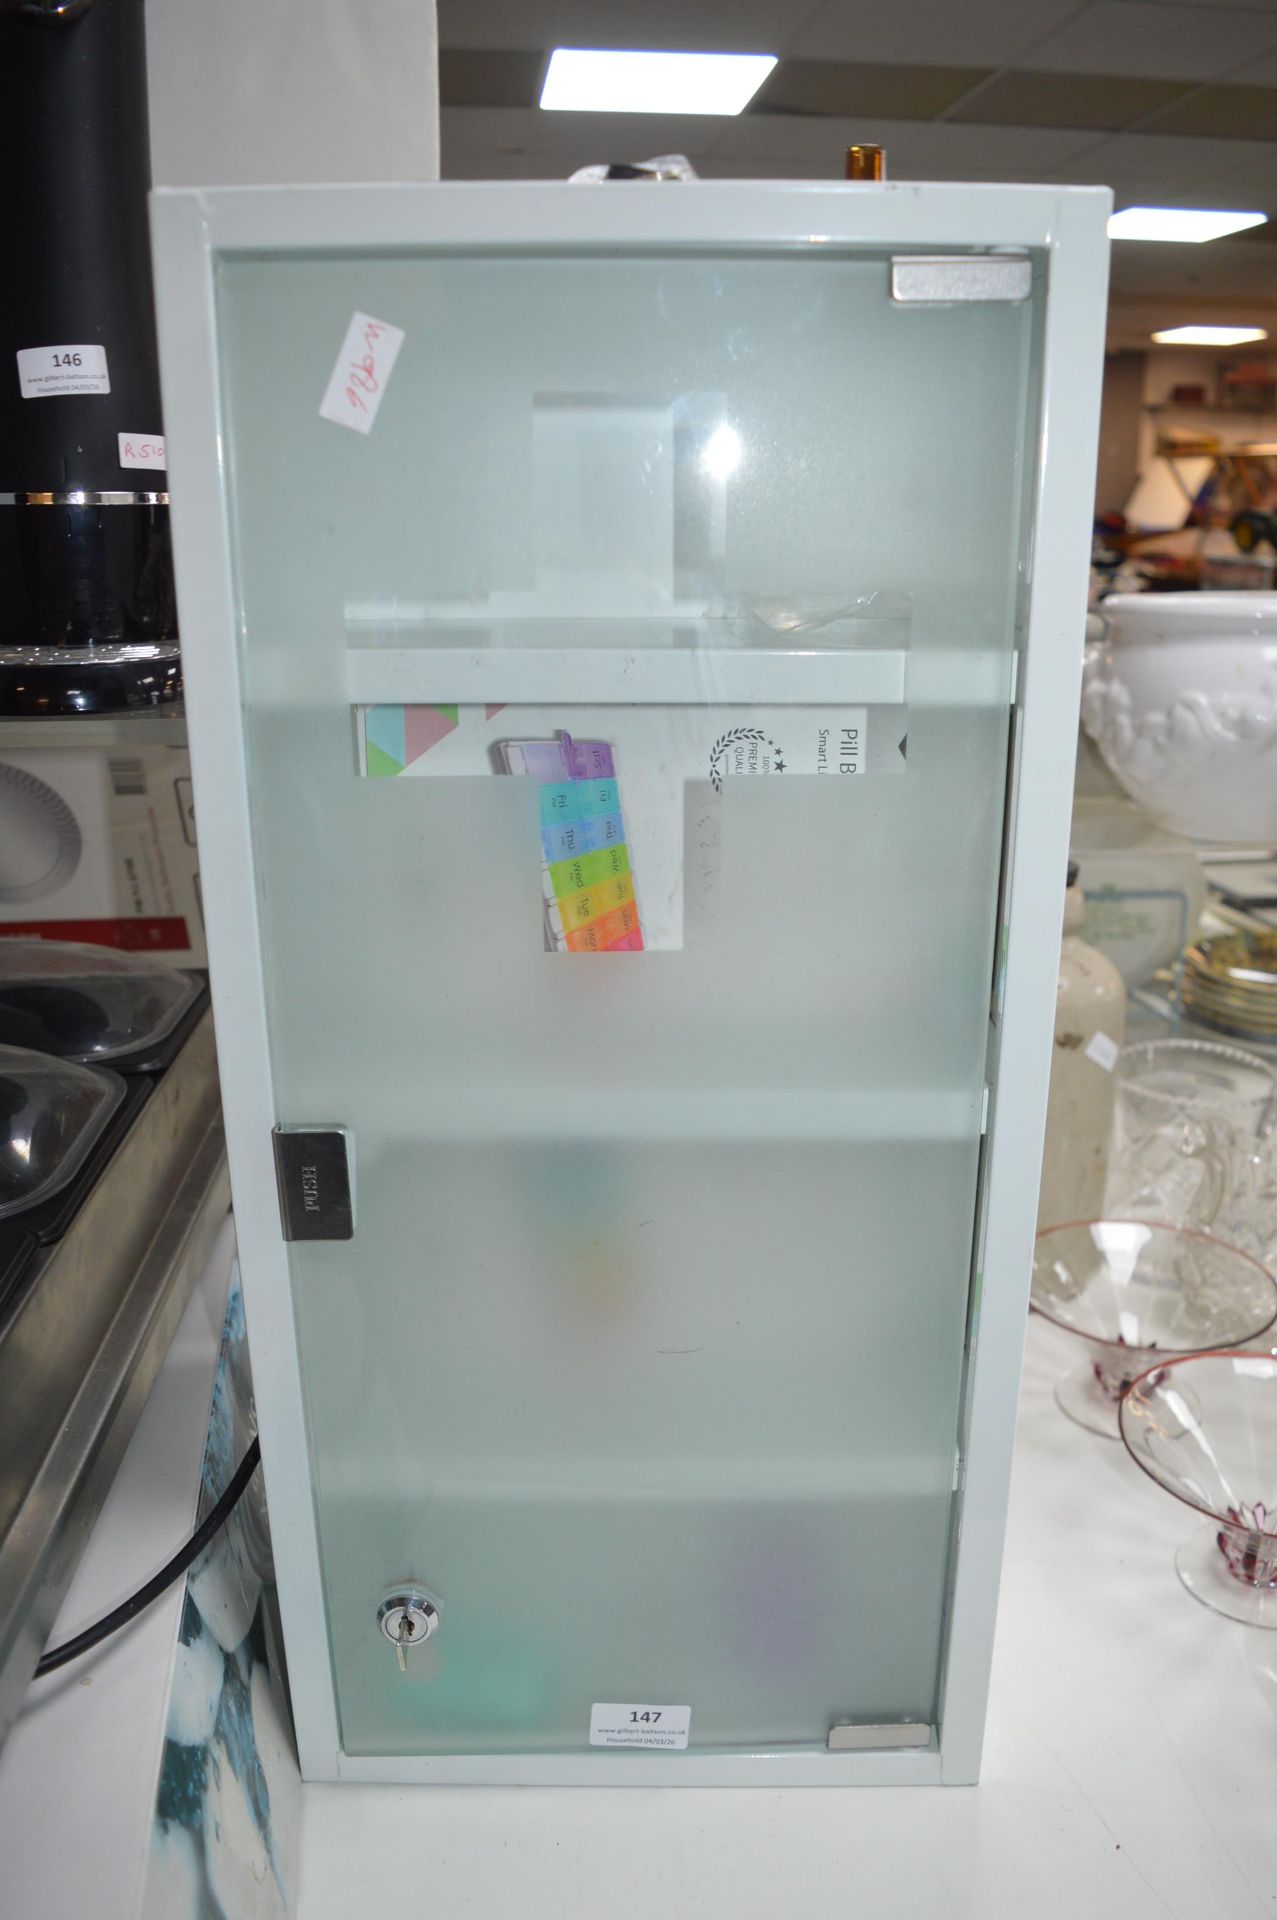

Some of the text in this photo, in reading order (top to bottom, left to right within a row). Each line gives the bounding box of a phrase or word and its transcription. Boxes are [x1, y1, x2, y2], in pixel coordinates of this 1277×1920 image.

[52, 353, 82, 367] 146
[748, 742, 758, 774] PREMI
[818, 729, 830, 763] Smart
[839, 729, 858, 774] Pill B
[557, 794, 569, 808] Fri
[565, 830, 577, 850] Thu
[573, 861, 584, 888] Wed
[302, 1166, 320, 1212] PUSH
[629, 1711, 662, 1723] 147
